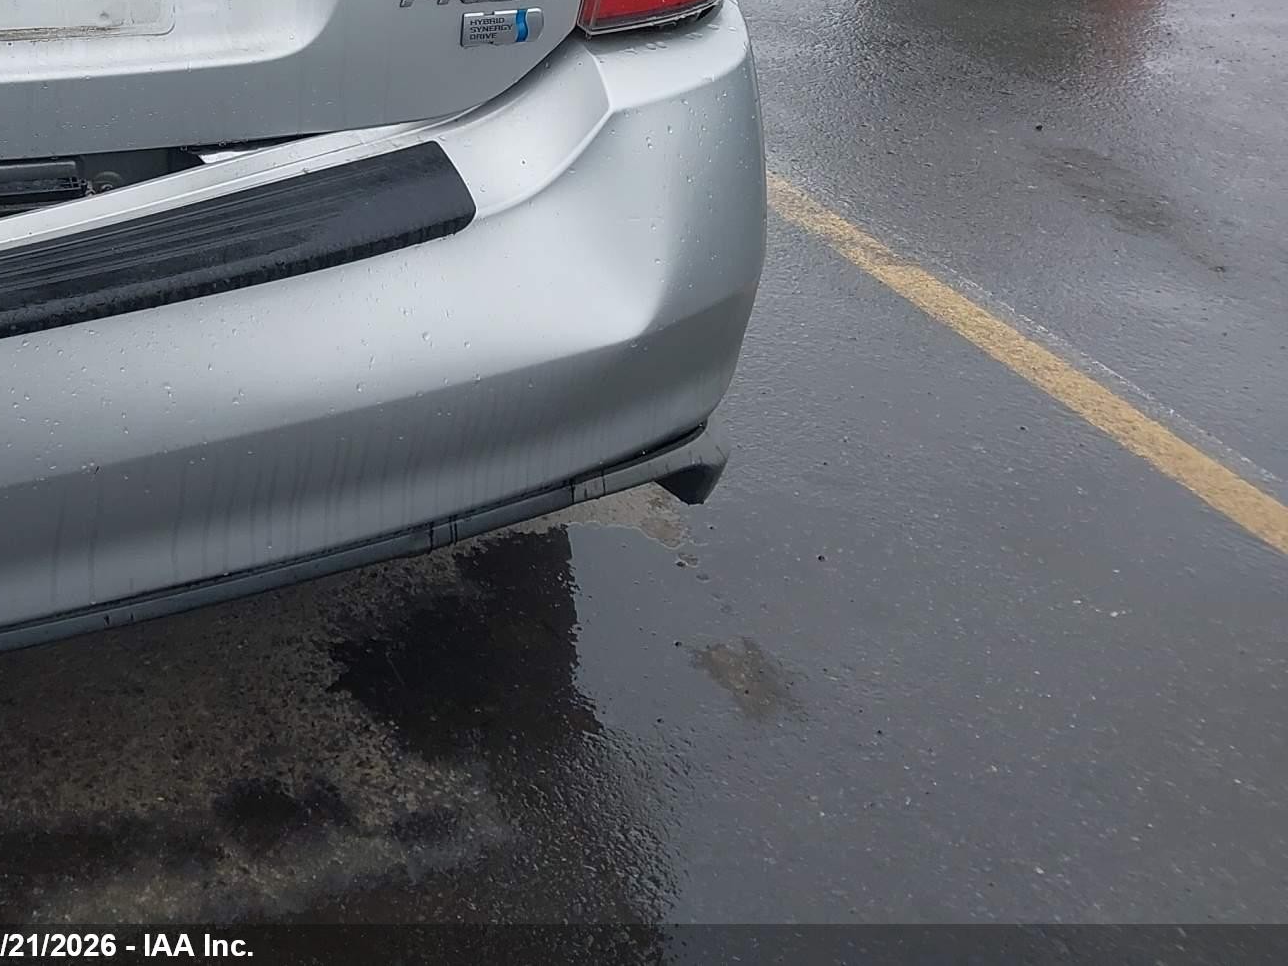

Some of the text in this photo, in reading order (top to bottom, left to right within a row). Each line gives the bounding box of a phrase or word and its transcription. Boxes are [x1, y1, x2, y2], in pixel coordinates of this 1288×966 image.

[470, 17, 505, 25] HYBRID
[470, 24, 513, 33] SYNERGY
[469, 32, 497, 40] DRIVE
